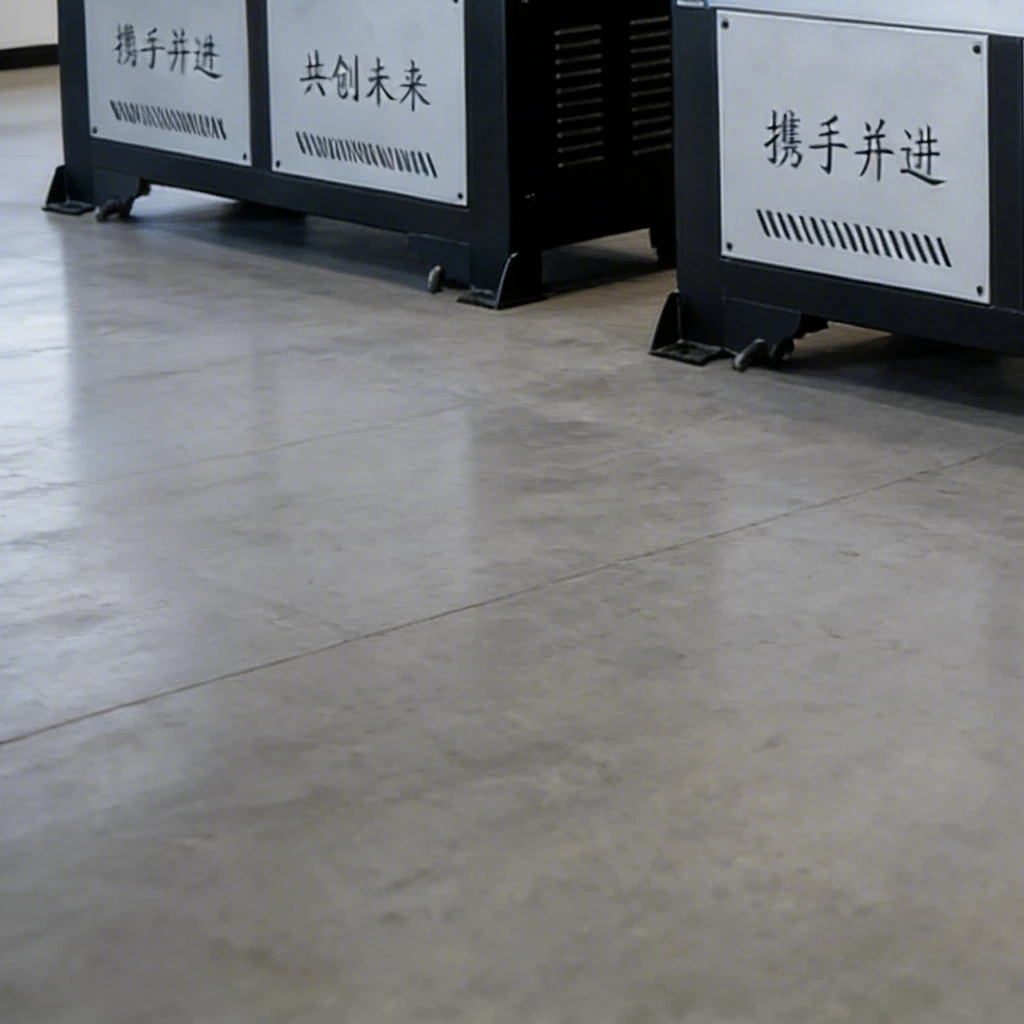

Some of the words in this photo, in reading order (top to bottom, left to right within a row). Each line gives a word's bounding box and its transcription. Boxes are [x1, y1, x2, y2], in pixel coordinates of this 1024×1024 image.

[300, 49, 431, 112] 共创未来
[764, 109, 948, 186] 携手并进
